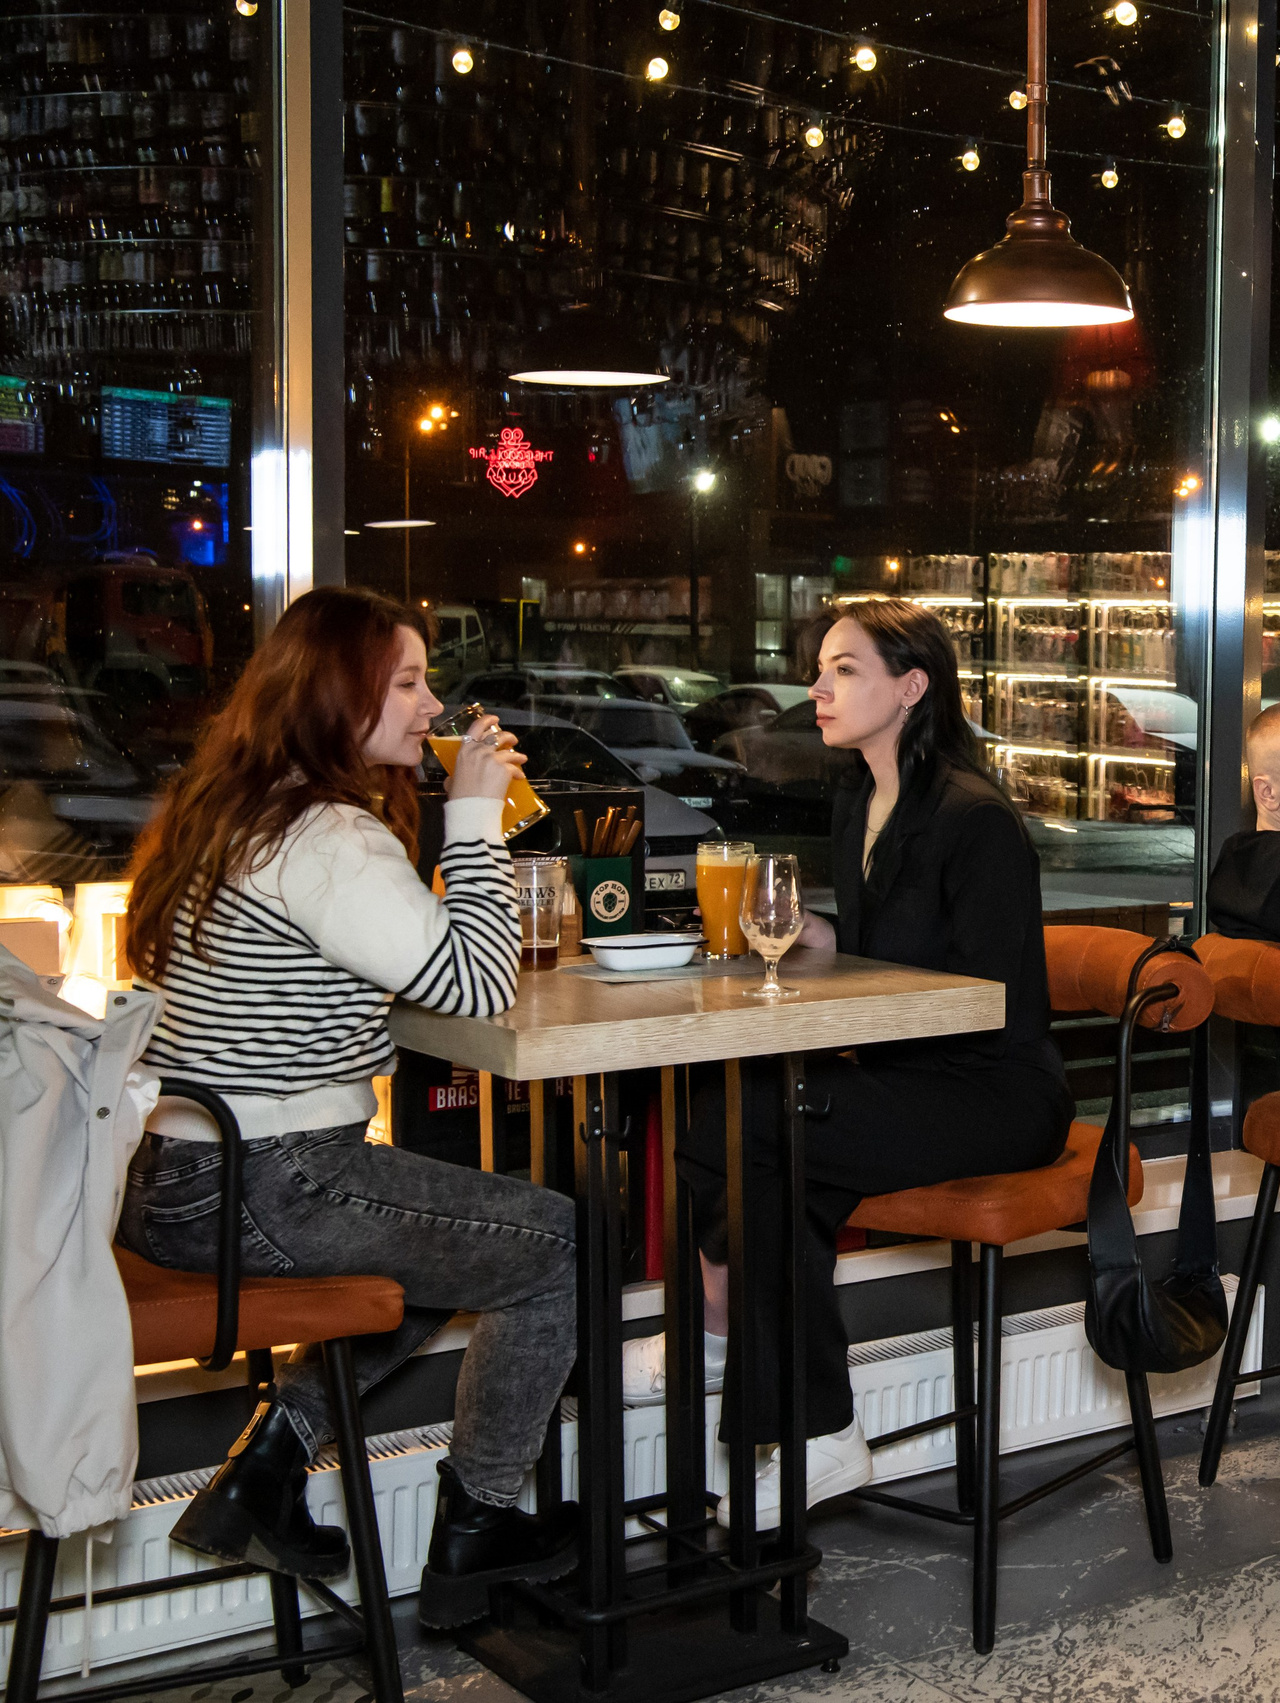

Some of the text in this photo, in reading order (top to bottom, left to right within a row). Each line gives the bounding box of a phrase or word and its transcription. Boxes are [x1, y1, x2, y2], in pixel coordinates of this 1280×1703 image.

[517, 886, 556, 899] JAWS
[594, 883, 626, 896] TOP HOP
[506, 1102, 530, 1114] BRUSS
